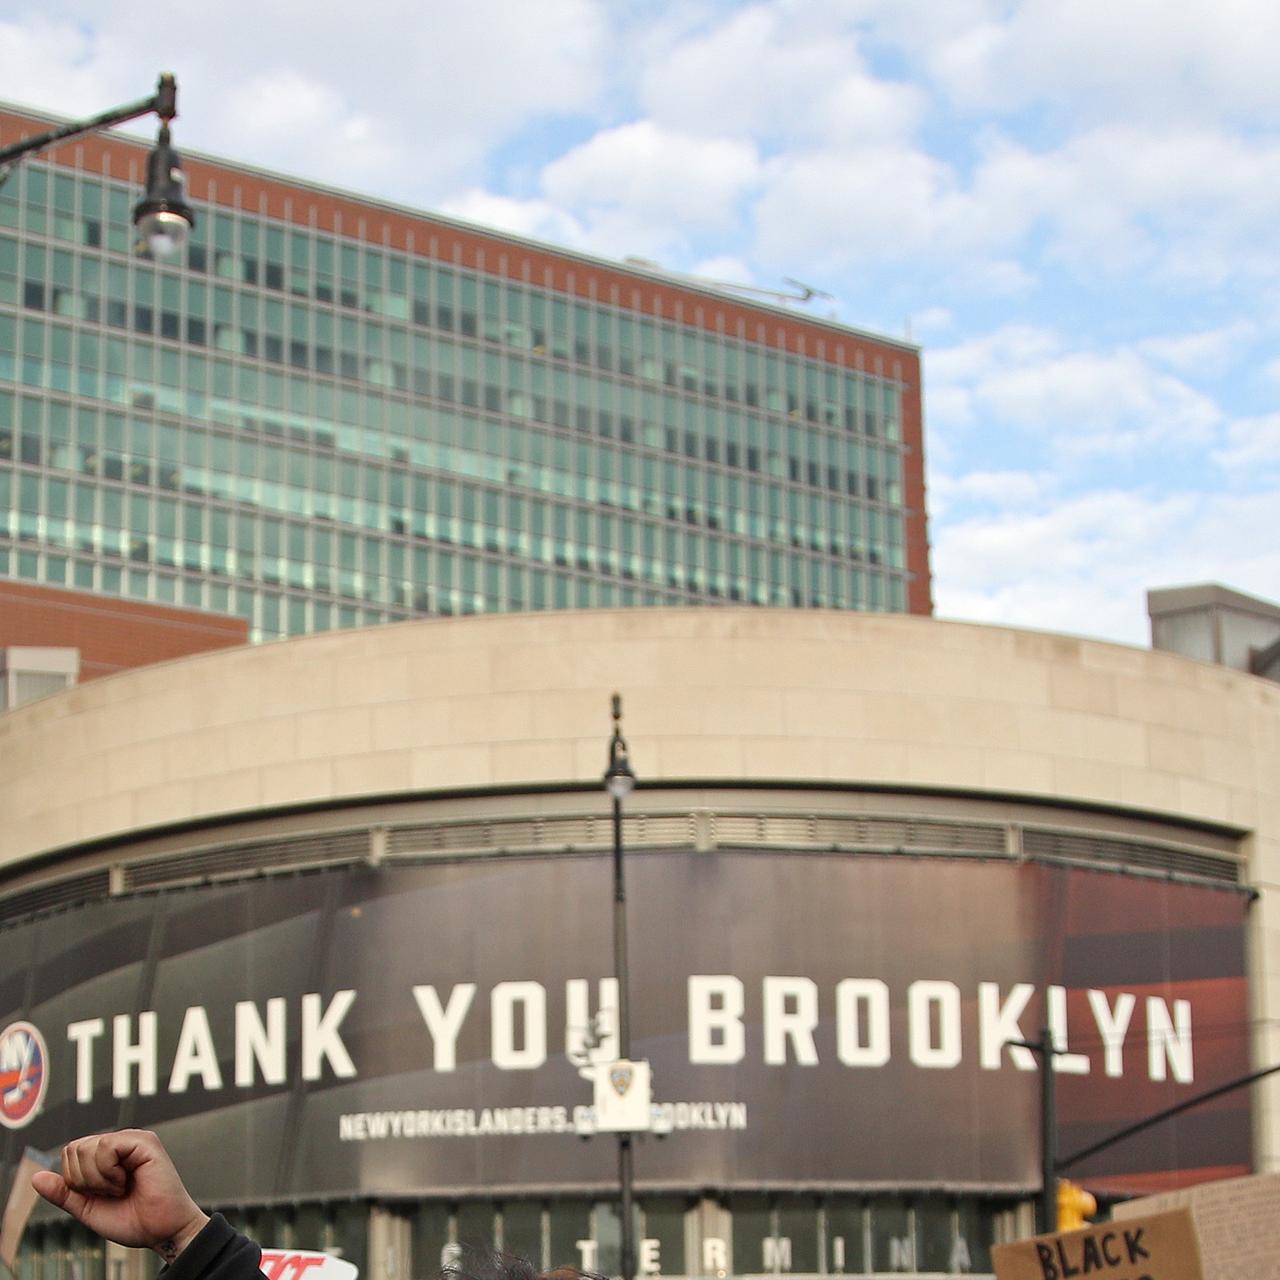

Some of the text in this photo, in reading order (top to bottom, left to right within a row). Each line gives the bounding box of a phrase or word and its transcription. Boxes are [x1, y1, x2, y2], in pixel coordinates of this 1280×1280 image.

[67, 974, 1195, 1103] THANK YOU BROOKLYN
[576, 1235, 972, 1277] TERMINA
